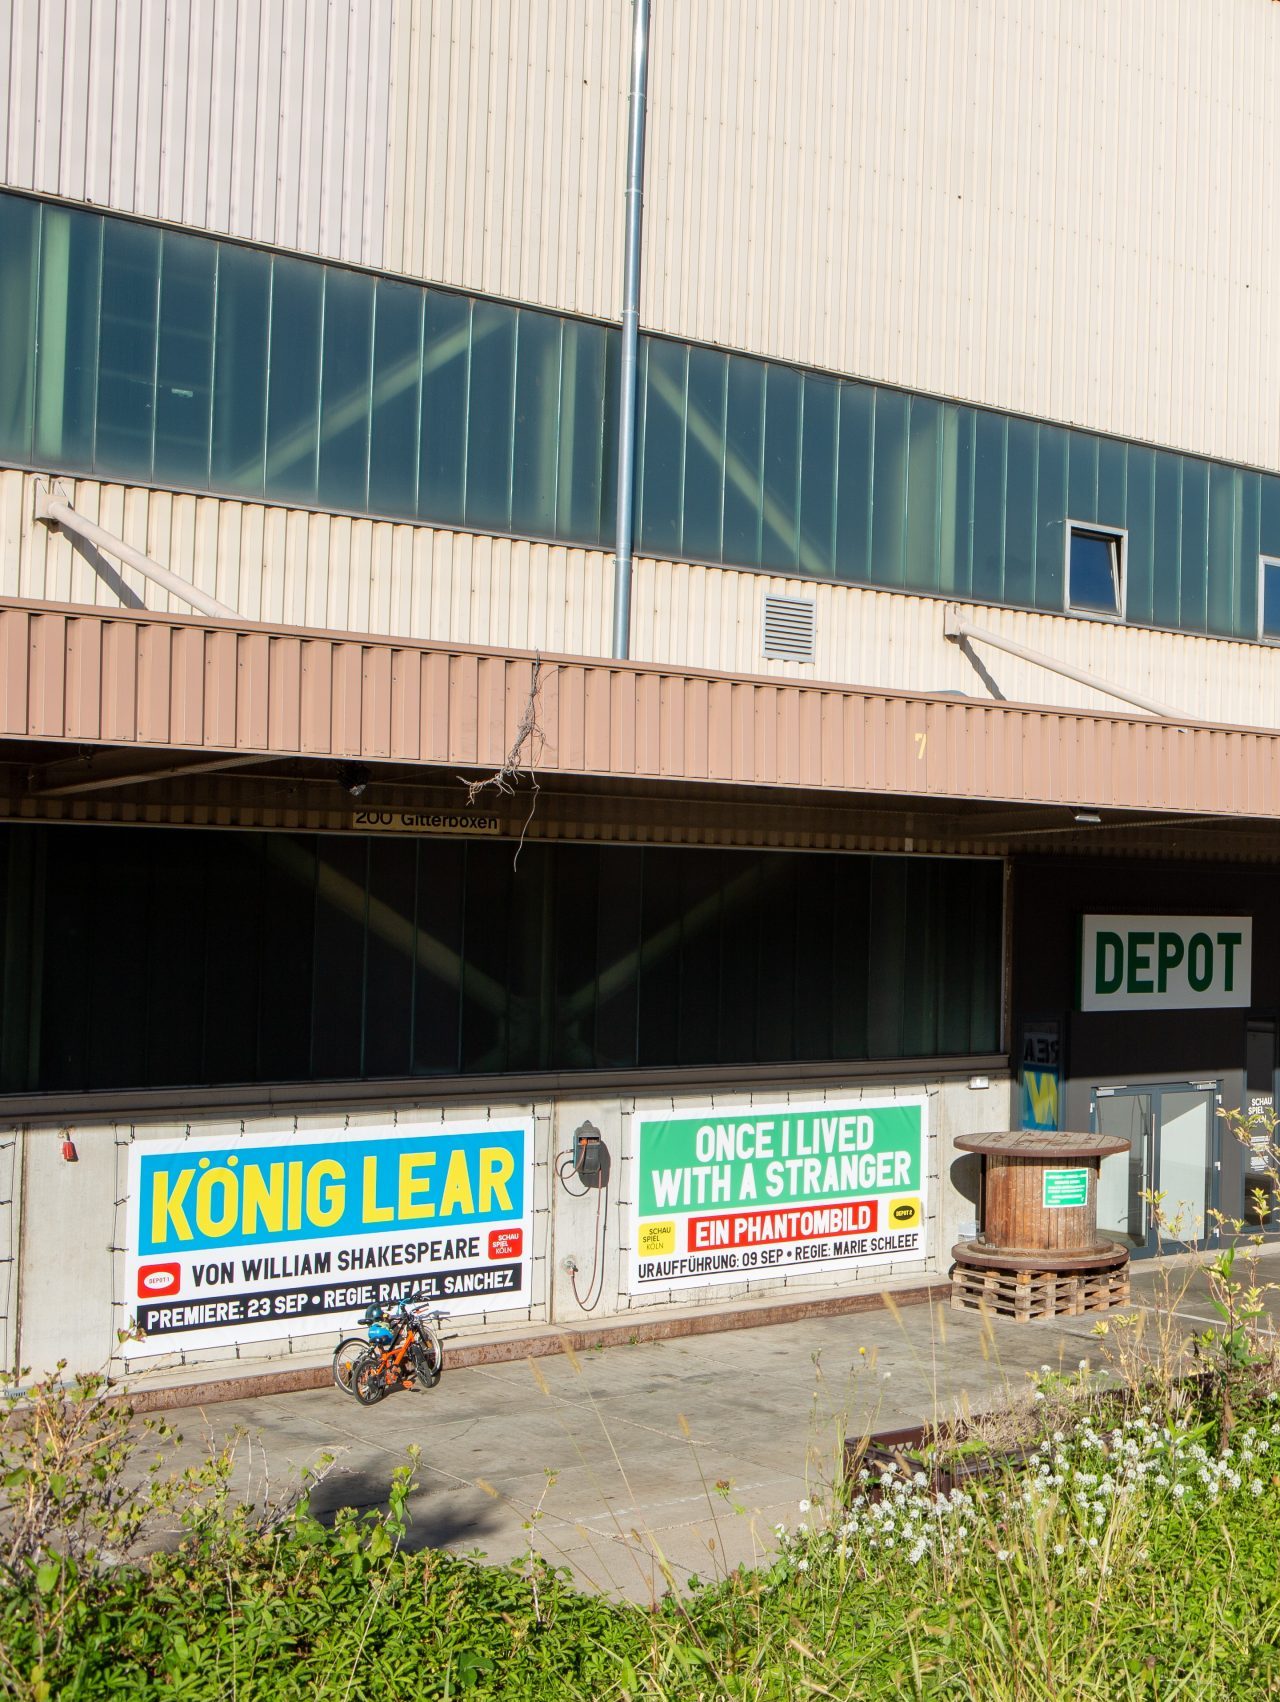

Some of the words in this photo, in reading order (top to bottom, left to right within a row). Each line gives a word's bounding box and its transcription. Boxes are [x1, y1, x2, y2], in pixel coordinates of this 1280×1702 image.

[914, 733, 927, 760] 7
[1095, 931, 1242, 995] DEPOT
[1248, 1106, 1264, 1115] SPIEL
[1251, 1096, 1273, 1107] SCHAU
[695, 1121, 775, 1163] ONCE
[782, 1120, 790, 1157] I
[796, 1115, 874, 1156] LIVED
[151, 1154, 346, 1244] KÖNIG
[362, 1146, 515, 1224] LEAR
[652, 1165, 732, 1208] WITH
[739, 1163, 757, 1201] A
[766, 1151, 911, 1197] STRANGER
[492, 1240, 509, 1248] SPIEL
[497, 1232, 520, 1241] SCHAU
[642, 1234, 660, 1243] SPIEL
[649, 1226, 671, 1236] SCHAU
[695, 1218, 732, 1248] EIN
[734, 1206, 871, 1244] PHANTOMBILD
[192, 1260, 235, 1288] VON
[242, 1251, 331, 1282] WILLIAM
[338, 1236, 480, 1271] SHAKESPEARE
[495, 1246, 513, 1255] KÖLN
[638, 1255, 740, 1280] URAUFFÜHRUNG:
[742, 1252, 758, 1268] 09
[761, 1250, 784, 1265] SEP
[795, 1243, 831, 1261] REGIE:
[833, 1239, 868, 1257] MARIE
[870, 1233, 919, 1252] SCHLEEF
[147, 1302, 244, 1330] PREMIERE:
[248, 1297, 271, 1318] 23
[275, 1294, 309, 1315] SEP
[323, 1285, 377, 1309] REGIE:
[379, 1278, 440, 1303] RAFAEL
[444, 1269, 514, 1296] SANCHEZ
